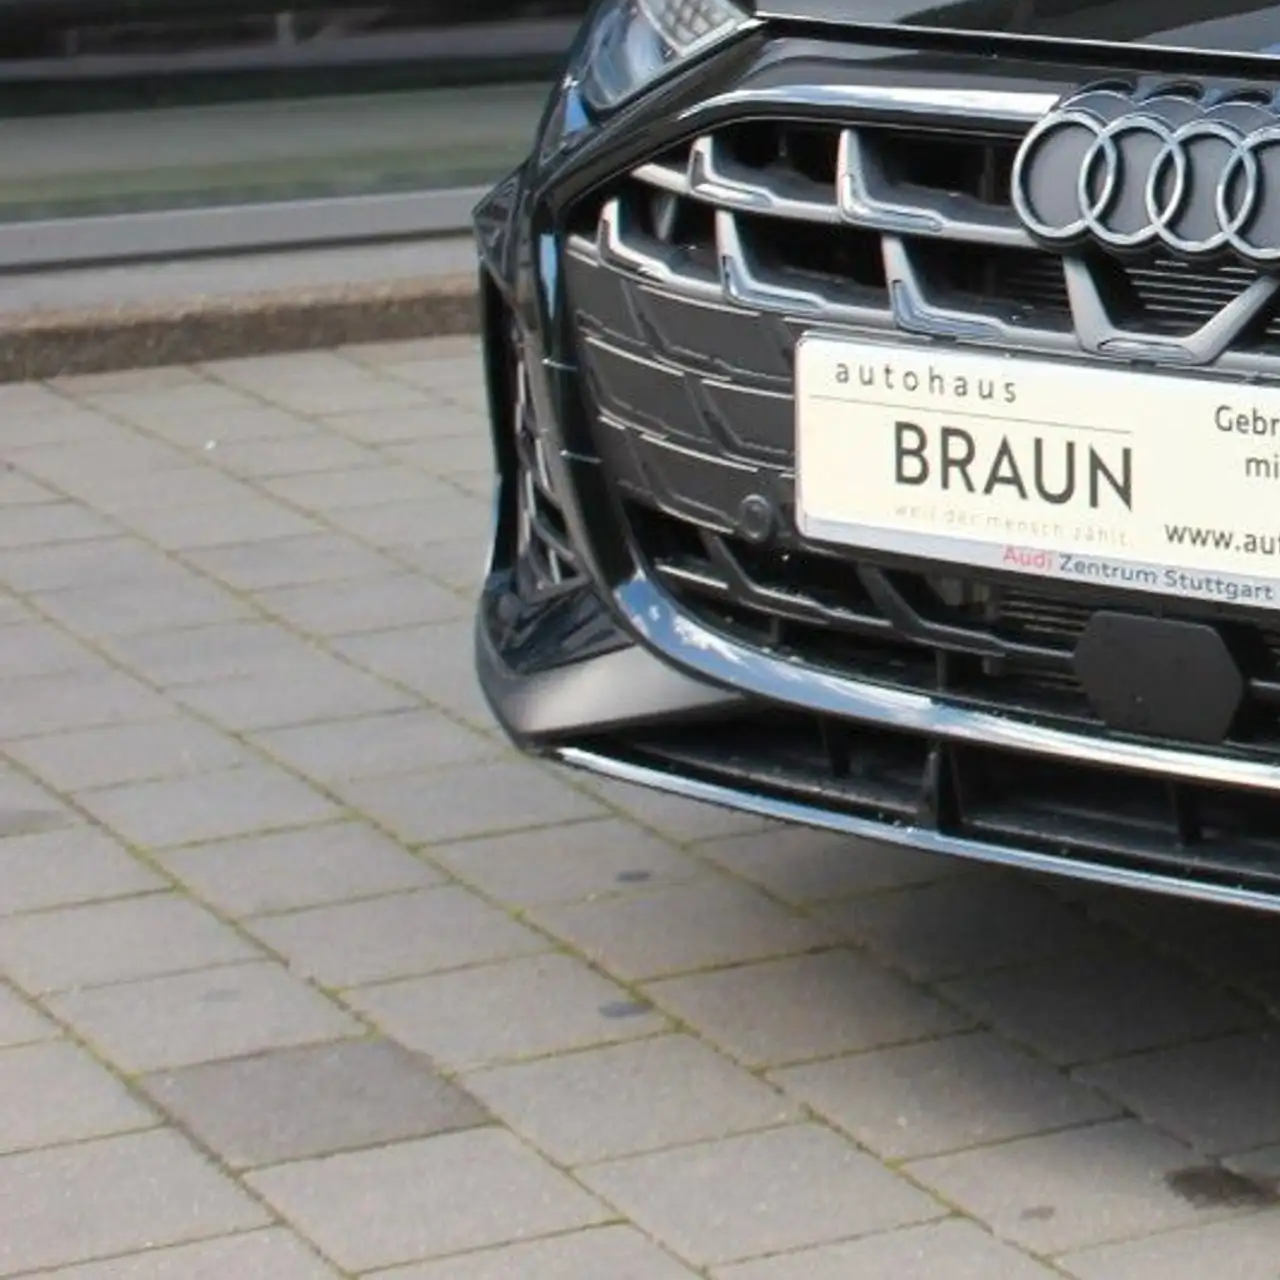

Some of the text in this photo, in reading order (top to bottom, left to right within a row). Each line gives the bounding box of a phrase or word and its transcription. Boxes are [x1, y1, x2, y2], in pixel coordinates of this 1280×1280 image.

[835, 362, 1018, 404] autohaus
[894, 420, 1134, 512] BRAUN
[1002, 544, 1275, 601] Audi Zentrum Stuttgart
